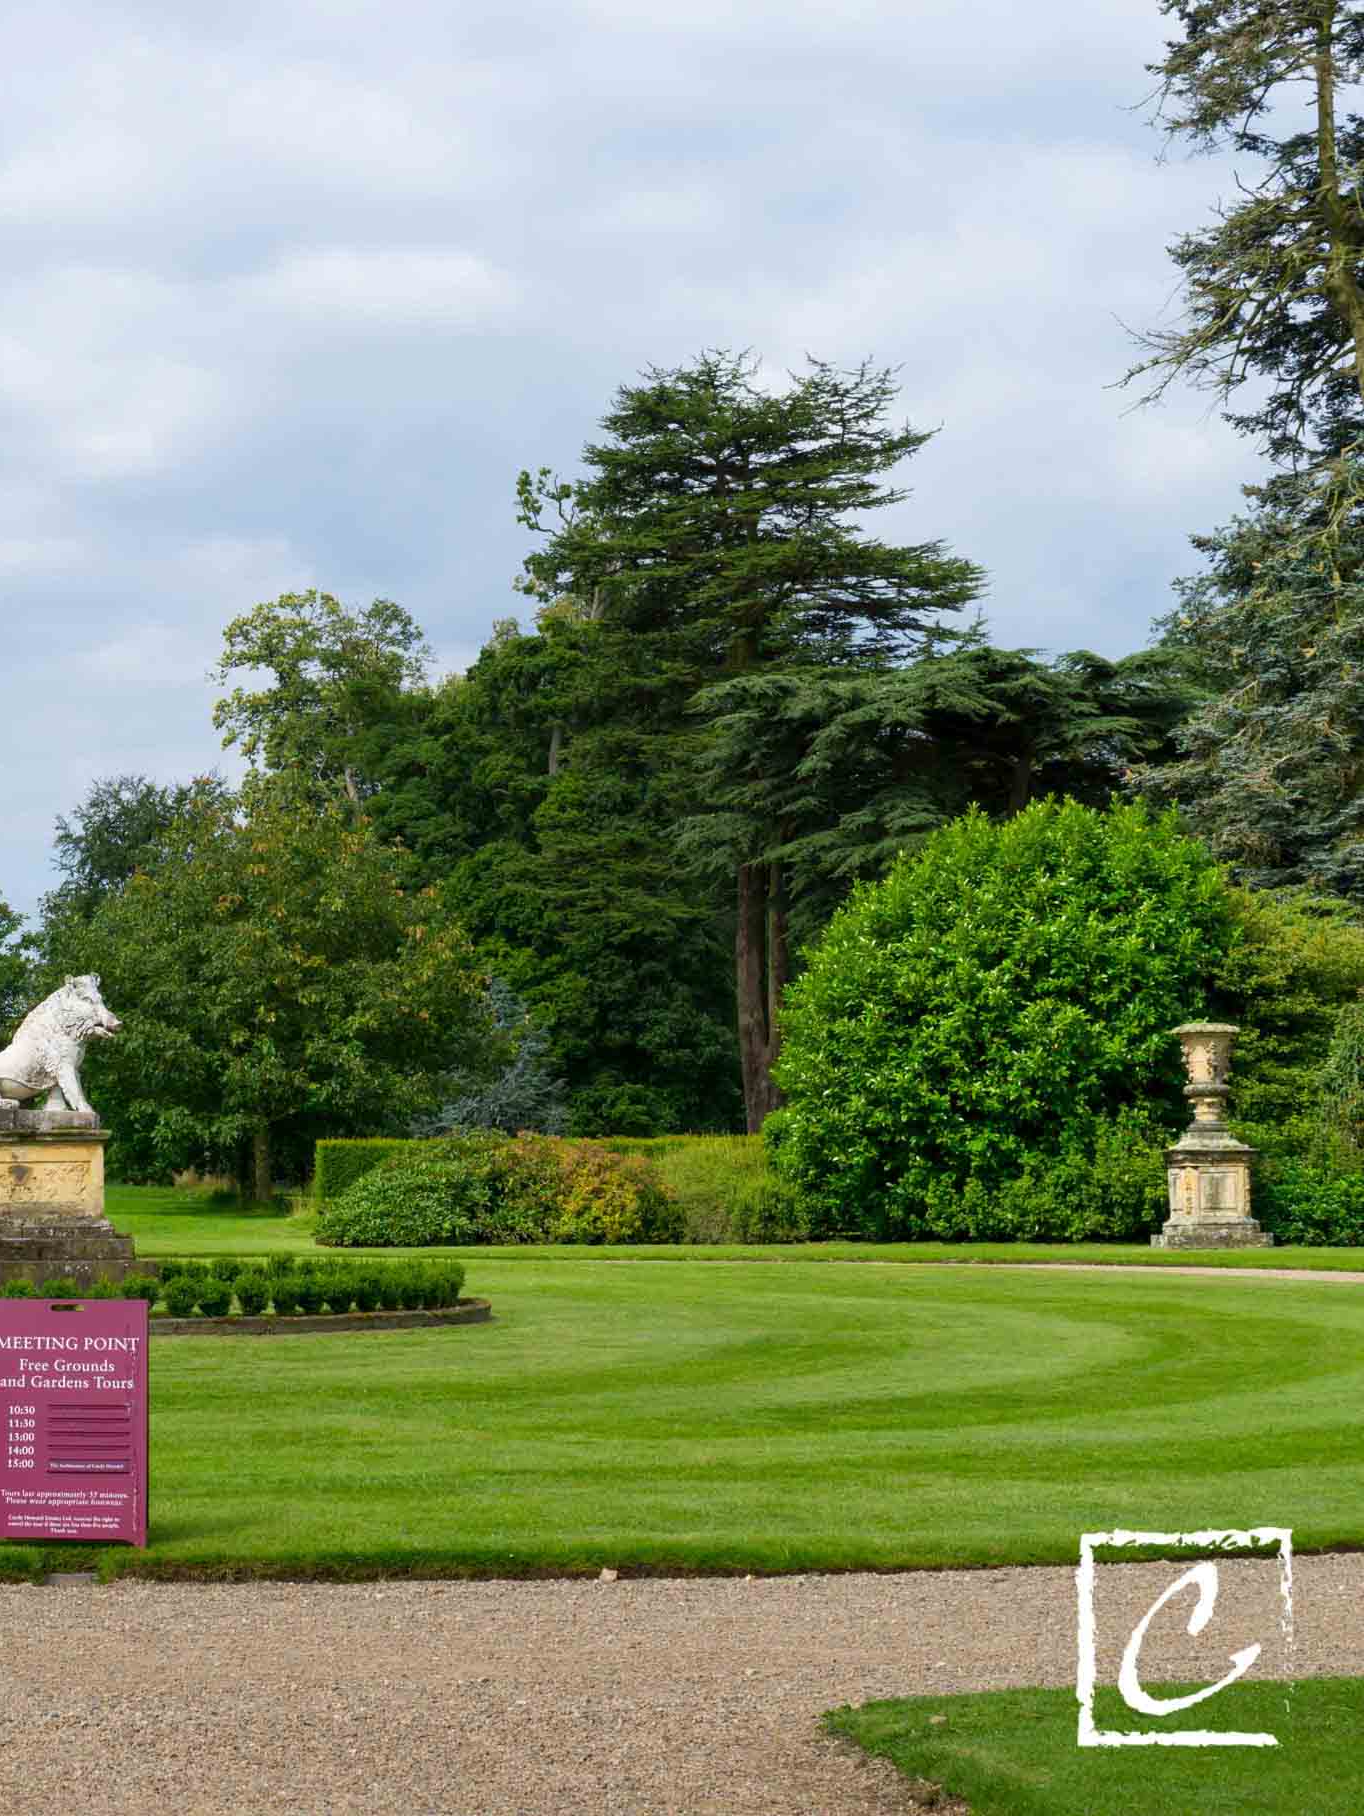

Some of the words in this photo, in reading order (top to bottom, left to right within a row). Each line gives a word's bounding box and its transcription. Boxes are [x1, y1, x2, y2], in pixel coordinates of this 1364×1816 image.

[84, 1337, 140, 1352] POINT
[19, 1358, 49, 1371] Free
[54, 1359, 115, 1373] Grounds
[0, 1374, 26, 1388] and
[30, 1375, 89, 1389] Gardens
[93, 1376, 134, 1390] Tours
[9, 1405, 36, 1415] 10:30
[8, 1419, 35, 1428] 11:30
[8, 1432, 35, 1441] 13:00
[7, 1446, 35, 1455] 14:00
[7, 1459, 34, 1469] 15:00
[1, 1489, 20, 1497] Tours
